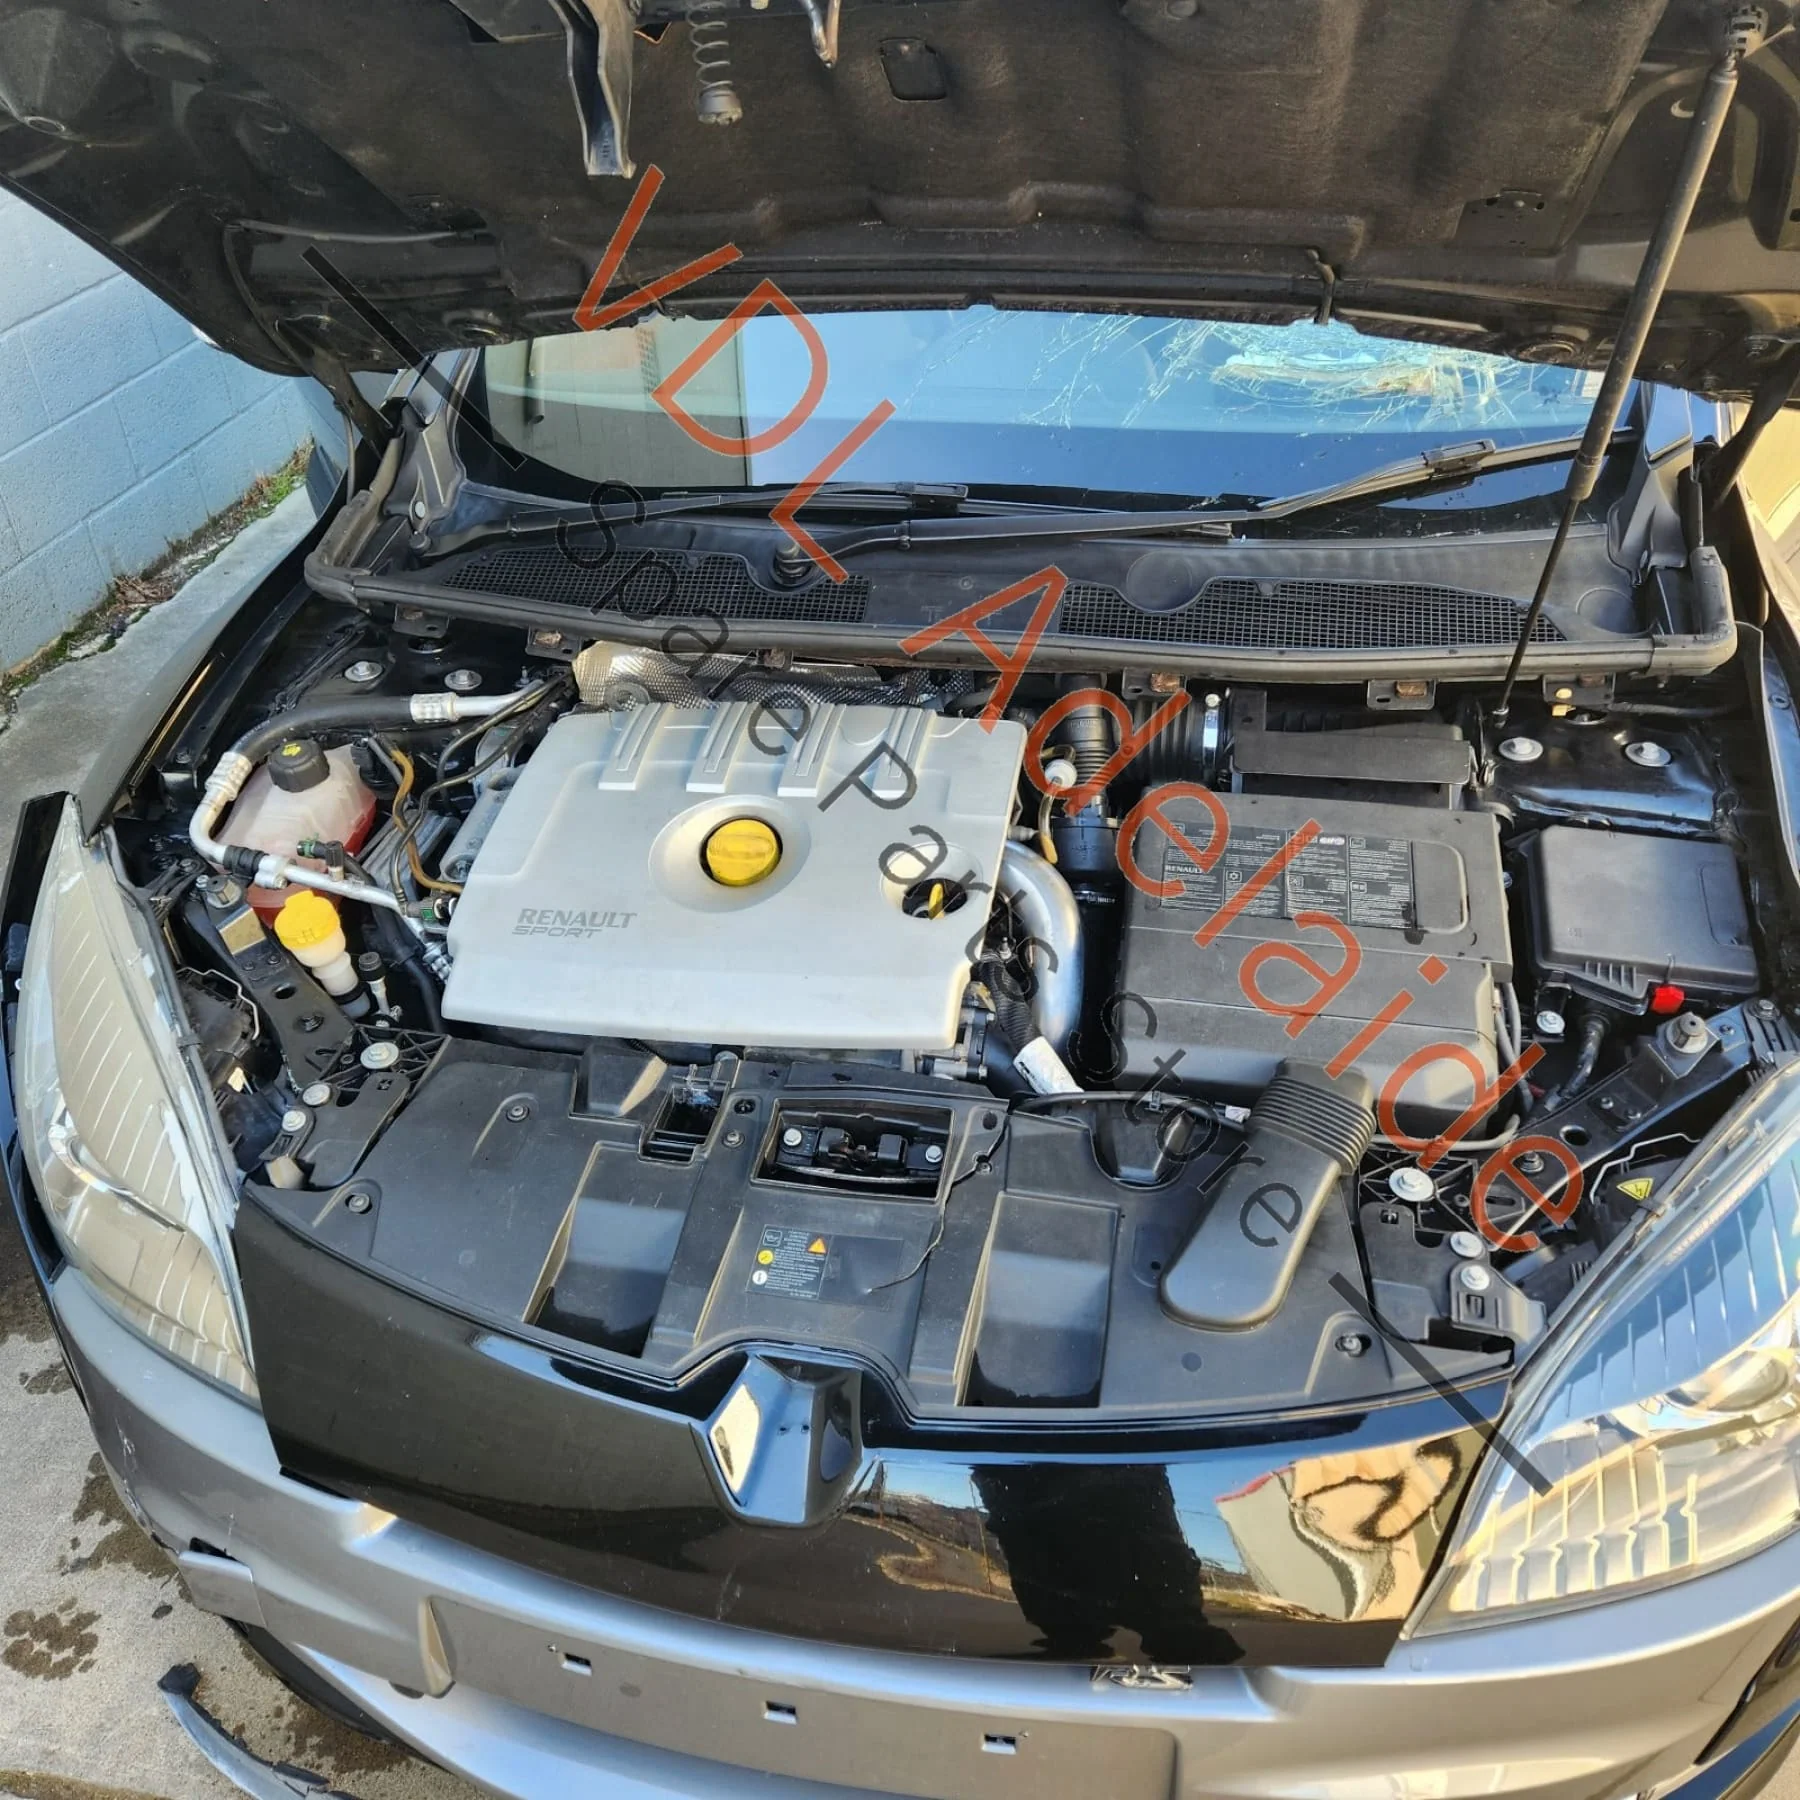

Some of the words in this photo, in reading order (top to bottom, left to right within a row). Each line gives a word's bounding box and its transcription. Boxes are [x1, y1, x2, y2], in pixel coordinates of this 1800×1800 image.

[1164, 865, 1207, 874] RENAUL
[517, 908, 637, 928] RENAULT
[512, 925, 602, 938] SPORT
